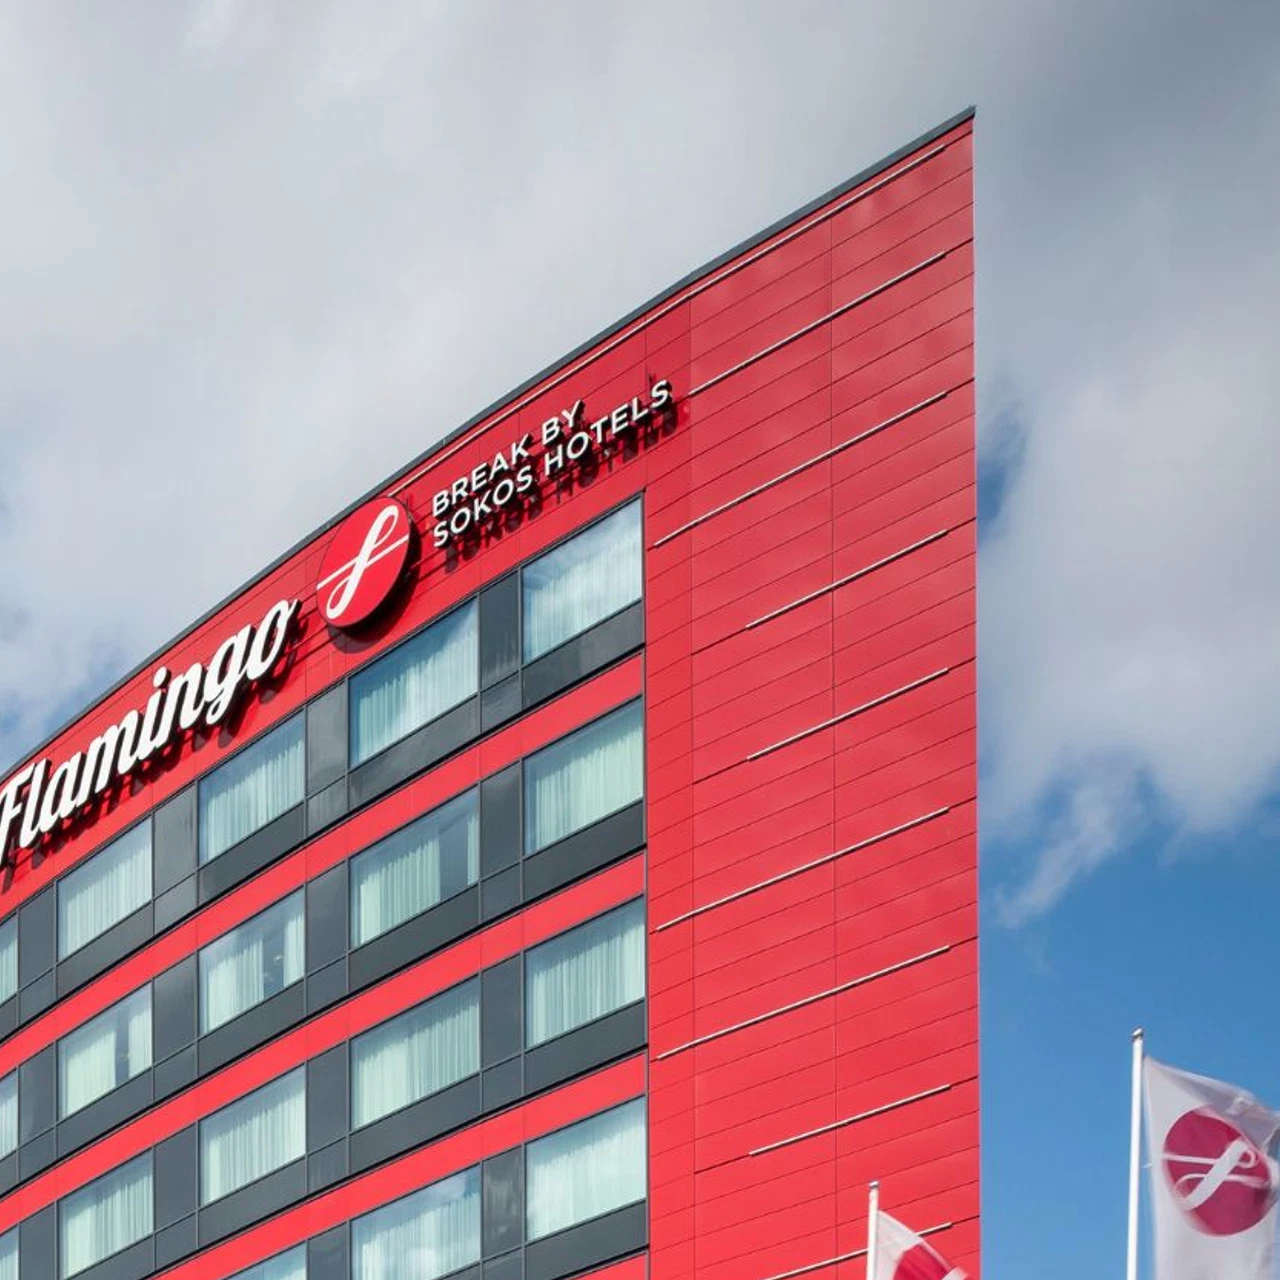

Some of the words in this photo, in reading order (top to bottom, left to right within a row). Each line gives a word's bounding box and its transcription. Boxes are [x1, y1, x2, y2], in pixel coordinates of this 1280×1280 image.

[432, 433, 532, 517] BREAK
[541, 399, 583, 445] BY
[433, 465, 532, 547] SOKOS
[544, 379, 670, 475] HOTELS
